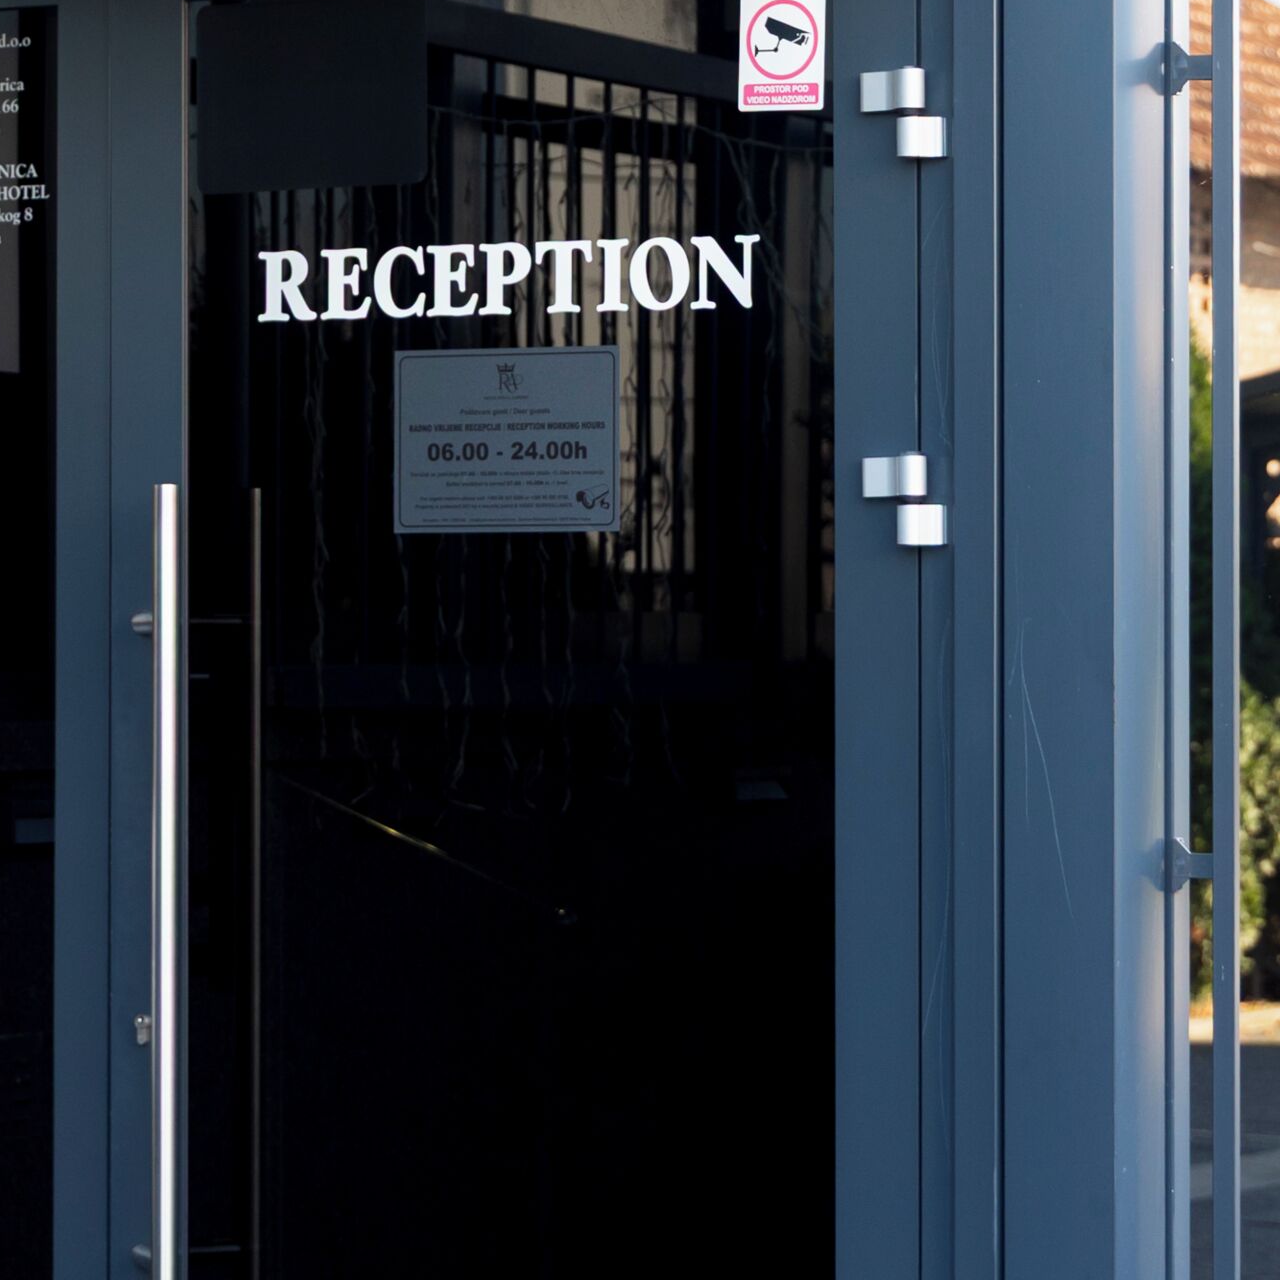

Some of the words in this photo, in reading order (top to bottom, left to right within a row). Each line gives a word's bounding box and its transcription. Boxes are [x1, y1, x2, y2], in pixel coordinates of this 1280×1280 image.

[754, 85, 791, 93] PROSTOR
[792, 84, 809, 93] POD
[747, 96, 770, 104] VIDEO
[771, 95, 816, 103] NADZOROM
[23, 206, 34, 222] 8
[257, 233, 761, 323] RECEPTION
[427, 442, 489, 461] 06.00
[510, 441, 588, 460] 24.00h
